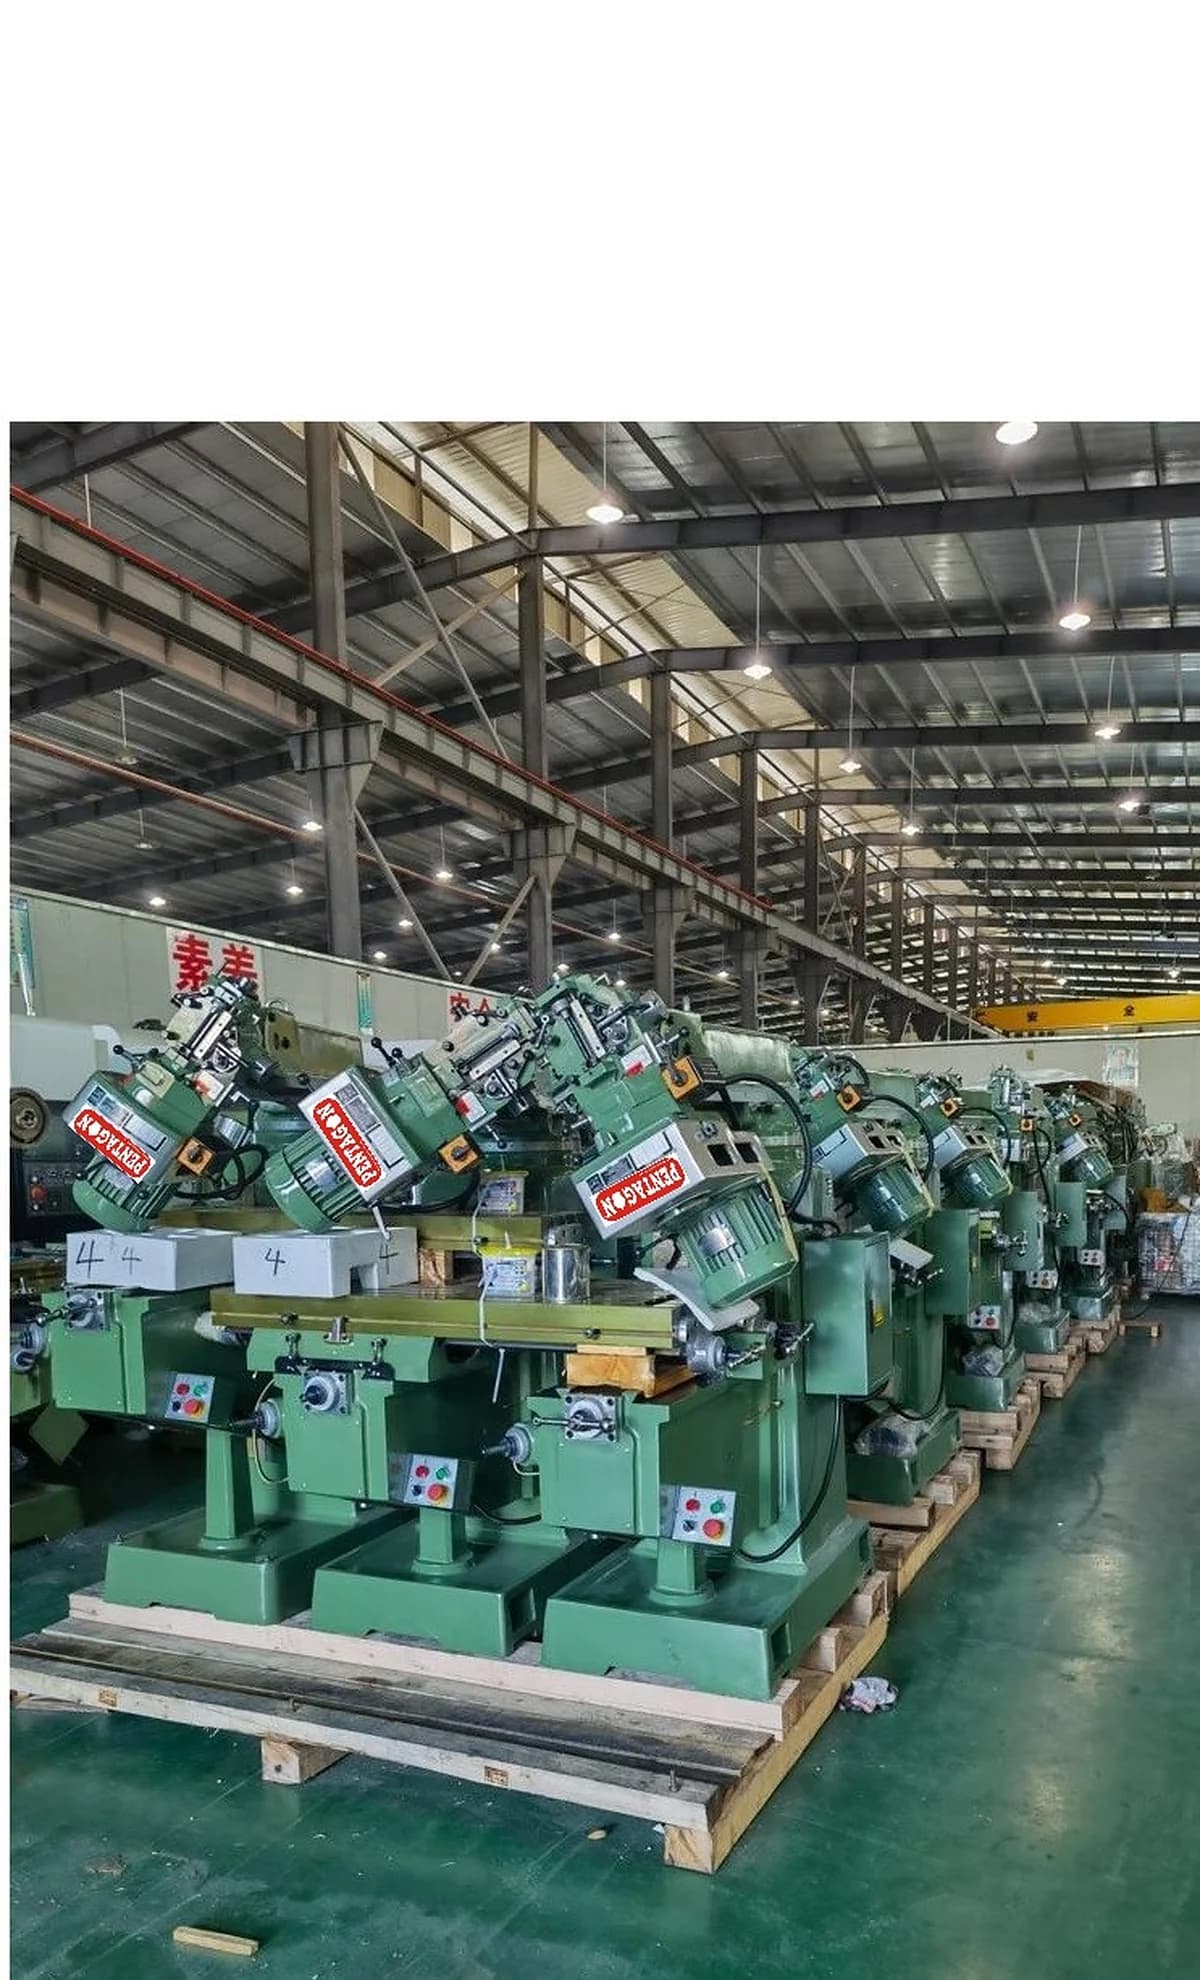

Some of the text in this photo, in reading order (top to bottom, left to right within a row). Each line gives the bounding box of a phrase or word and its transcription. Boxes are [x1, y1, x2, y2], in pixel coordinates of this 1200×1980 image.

[77, 1114, 148, 1175] PENTAGON
[316, 1103, 378, 1184] PENTAGON
[600, 1162, 683, 1218] PENTAGON
[76, 1240, 142, 1279] 4 4
[264, 1247, 286, 1276] 4
